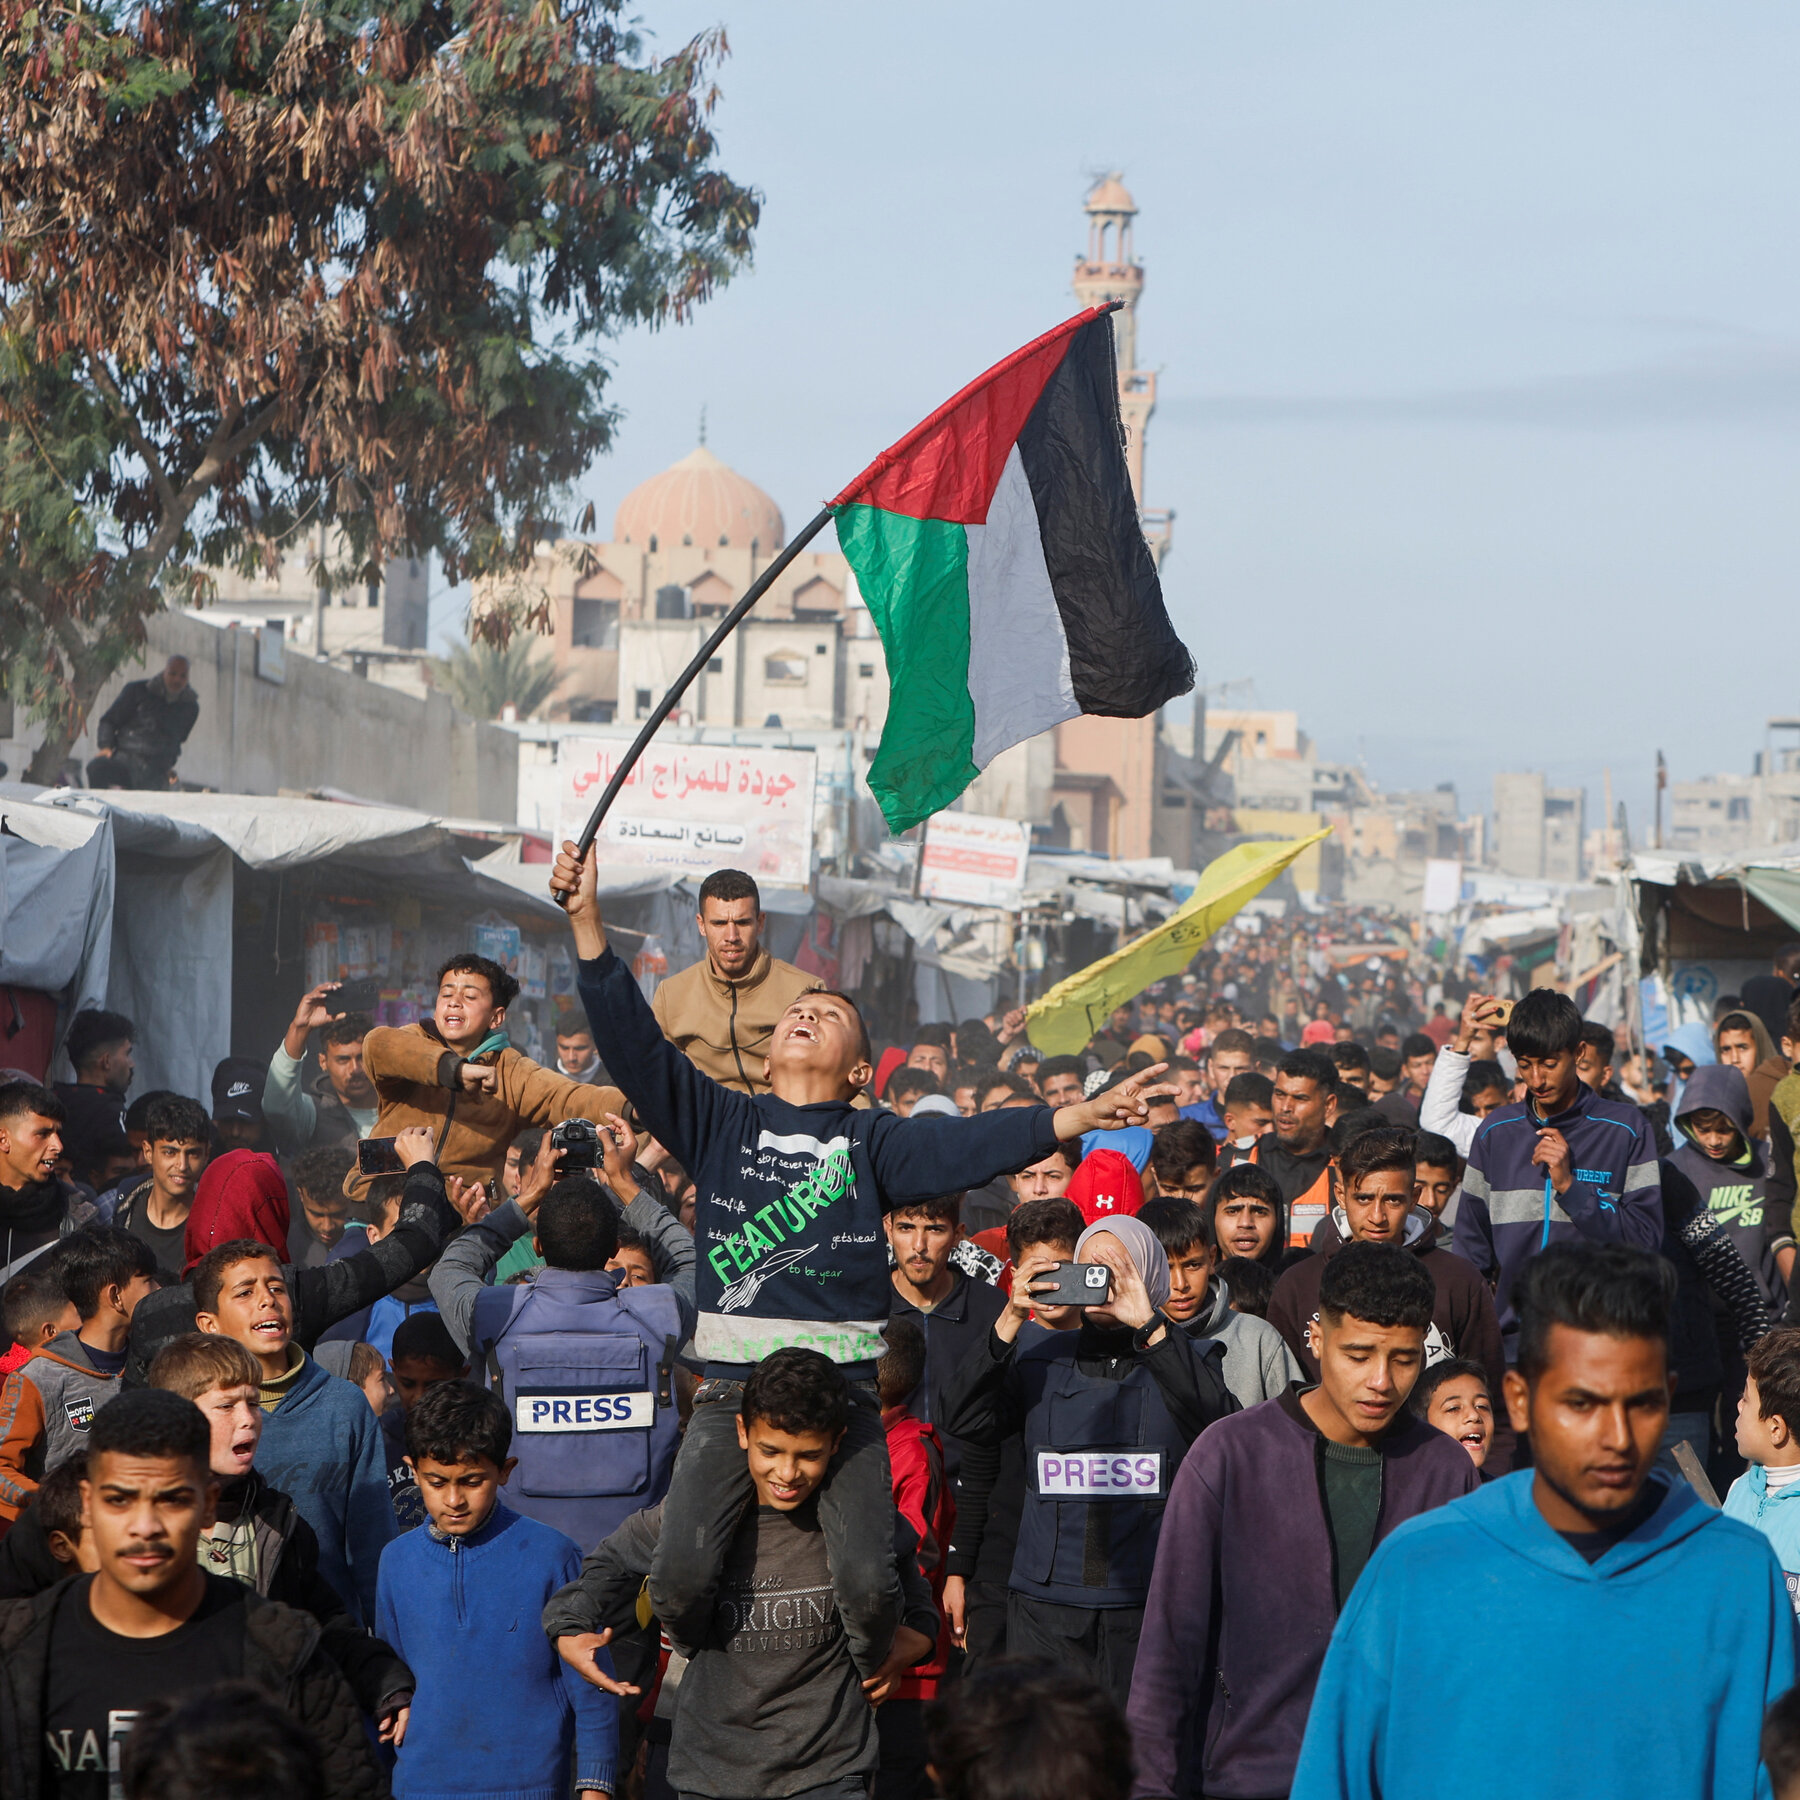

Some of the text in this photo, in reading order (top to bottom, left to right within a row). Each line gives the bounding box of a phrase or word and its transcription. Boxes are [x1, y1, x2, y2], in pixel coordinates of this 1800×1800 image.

[573, 751, 796, 808] جودة للمزاج الالي
[619, 821, 744, 848] صانع السعادة
[1573, 1168, 1612, 1185] URRENT
[1708, 1185, 1754, 1210] NIKE
[708, 1149, 857, 1285] FEATURED
[1738, 1207, 1764, 1227] SB
[789, 1264, 843, 1285] to be year
[74, 1405, 87, 1416] OFF
[532, 1396, 632, 1424] PRESS
[1043, 1458, 1156, 1487] PRESS
